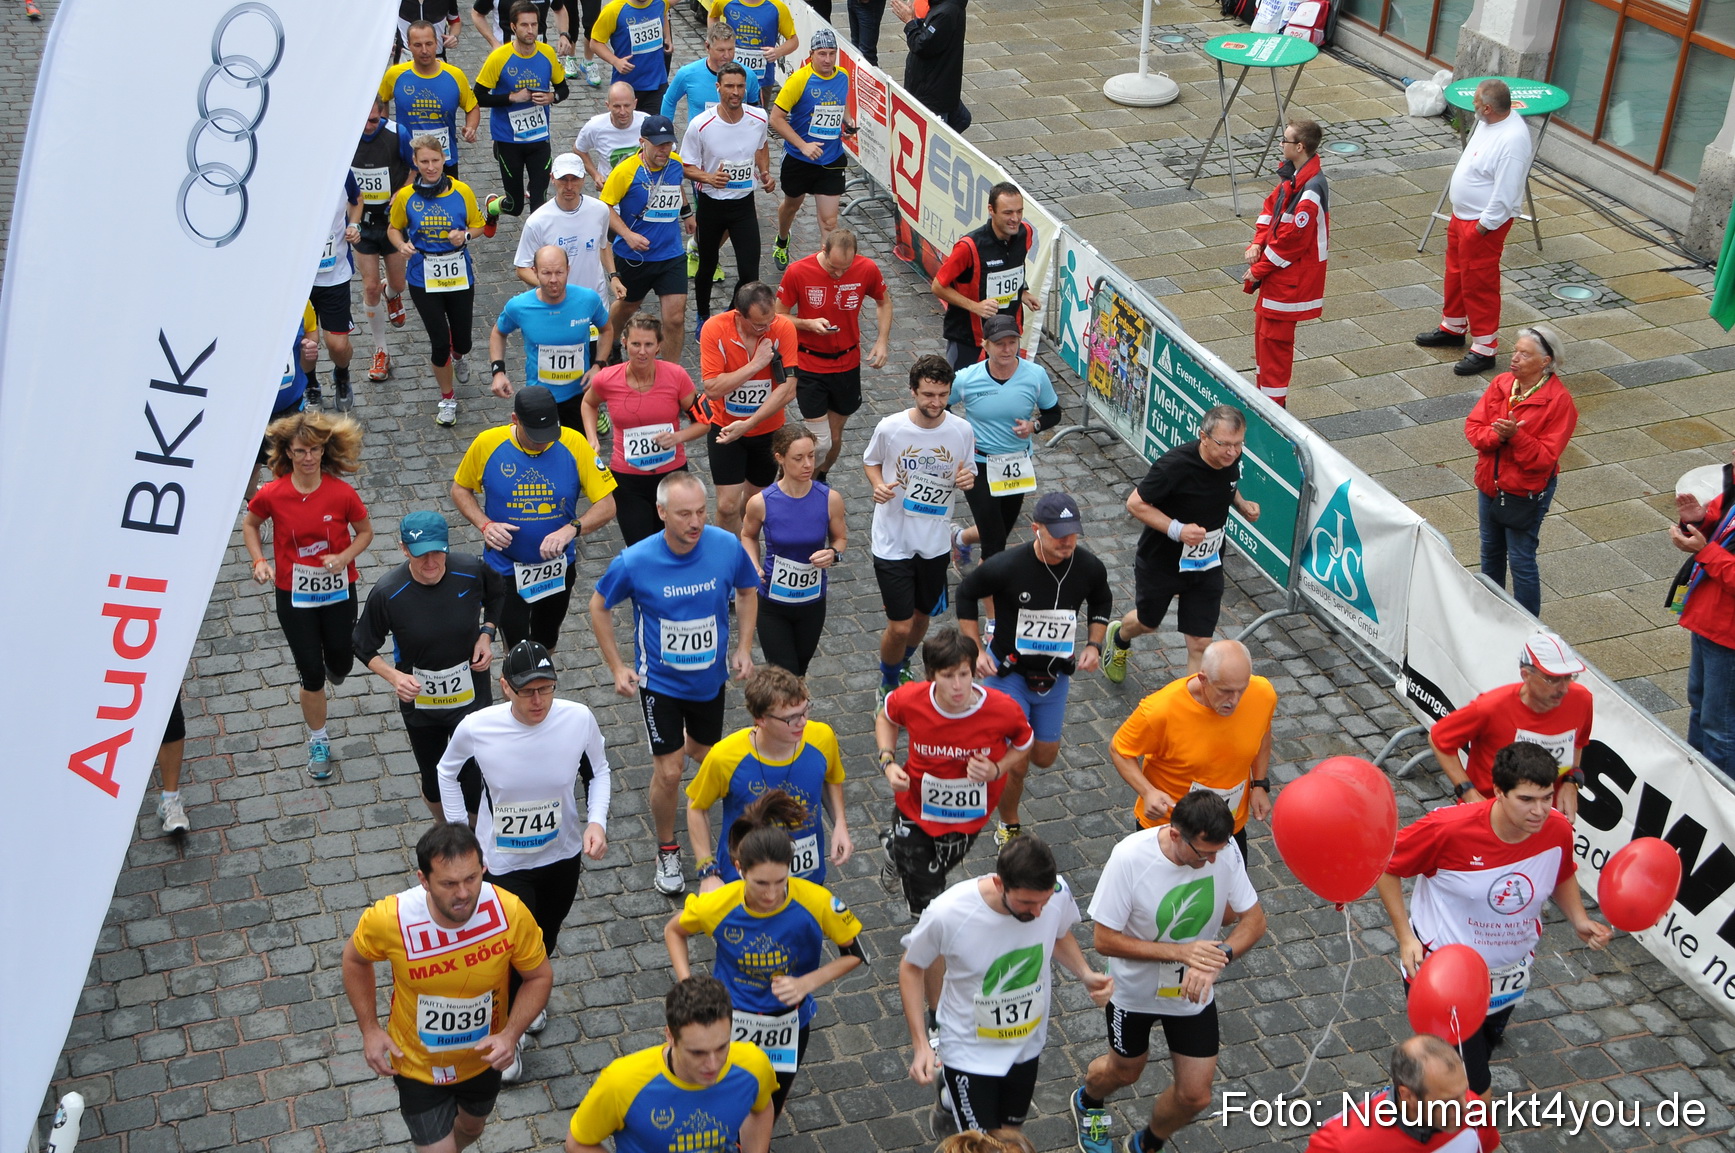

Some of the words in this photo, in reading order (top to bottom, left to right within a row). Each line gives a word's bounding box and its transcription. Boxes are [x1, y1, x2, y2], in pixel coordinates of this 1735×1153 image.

[634, 26, 660, 44] 3335
[514, 113, 545, 132] 2184
[815, 113, 842, 127] 2758
[357, 177, 383, 191] 258
[650, 195, 681, 209] 2847
[433, 262, 459, 278] 316
[437, 279, 457, 287] Sophie
[996, 277, 1018, 295] 196
[548, 354, 575, 370] 101
[551, 372, 572, 380] Daniel
[728, 389, 767, 405] 2922
[1153, 383, 1186, 425] Mehr
[1151, 408, 1169, 438] für
[640, 456, 663, 466] Andrea
[1002, 462, 1022, 478] 43
[1003, 481, 1020, 490] Petra
[910, 483, 953, 505] 2527
[912, 503, 938, 514] Mathias
[1238, 528, 1258, 555] 6352
[67, 573, 169, 799] Audi
[121, 327, 218, 536] BKK
[521, 562, 563, 586] 2793
[777, 568, 818, 588] 2093
[298, 573, 344, 592] 2635
[530, 580, 554, 596] Michael
[663, 577, 716, 599] Sinupret
[1332, 597, 1358, 623] Service
[1357, 616, 1379, 640] GmbH
[1022, 619, 1072, 641] 2757
[666, 630, 714, 652] 2709
[1032, 642, 1058, 652] Gerald
[675, 654, 706, 664] Günther
[433, 668, 462, 681] Neumarkt
[425, 676, 462, 696] 312
[432, 696, 458, 705] Enrico
[927, 788, 981, 808] 2280
[495, 806, 520, 814] PARTL
[520, 803, 551, 813] Neumarkt
[941, 808, 966, 818] David
[501, 811, 557, 835] 2744
[1467, 917, 1501, 929] LAUFEN
[1504, 921, 1520, 929] MIT
[408, 957, 459, 981] MAX
[463, 936, 516, 969] BÖGL
[419, 999, 444, 1010] PARTL
[445, 1000, 482, 1010] Neumarkt
[424, 1006, 487, 1032] 2039
[989, 999, 1033, 1027] 137
[755, 1018, 789, 1028] Neumarkt
[436, 1033, 473, 1045] Roland
[734, 1026, 793, 1047] 2480
[997, 1027, 1028, 1039] Stefan
